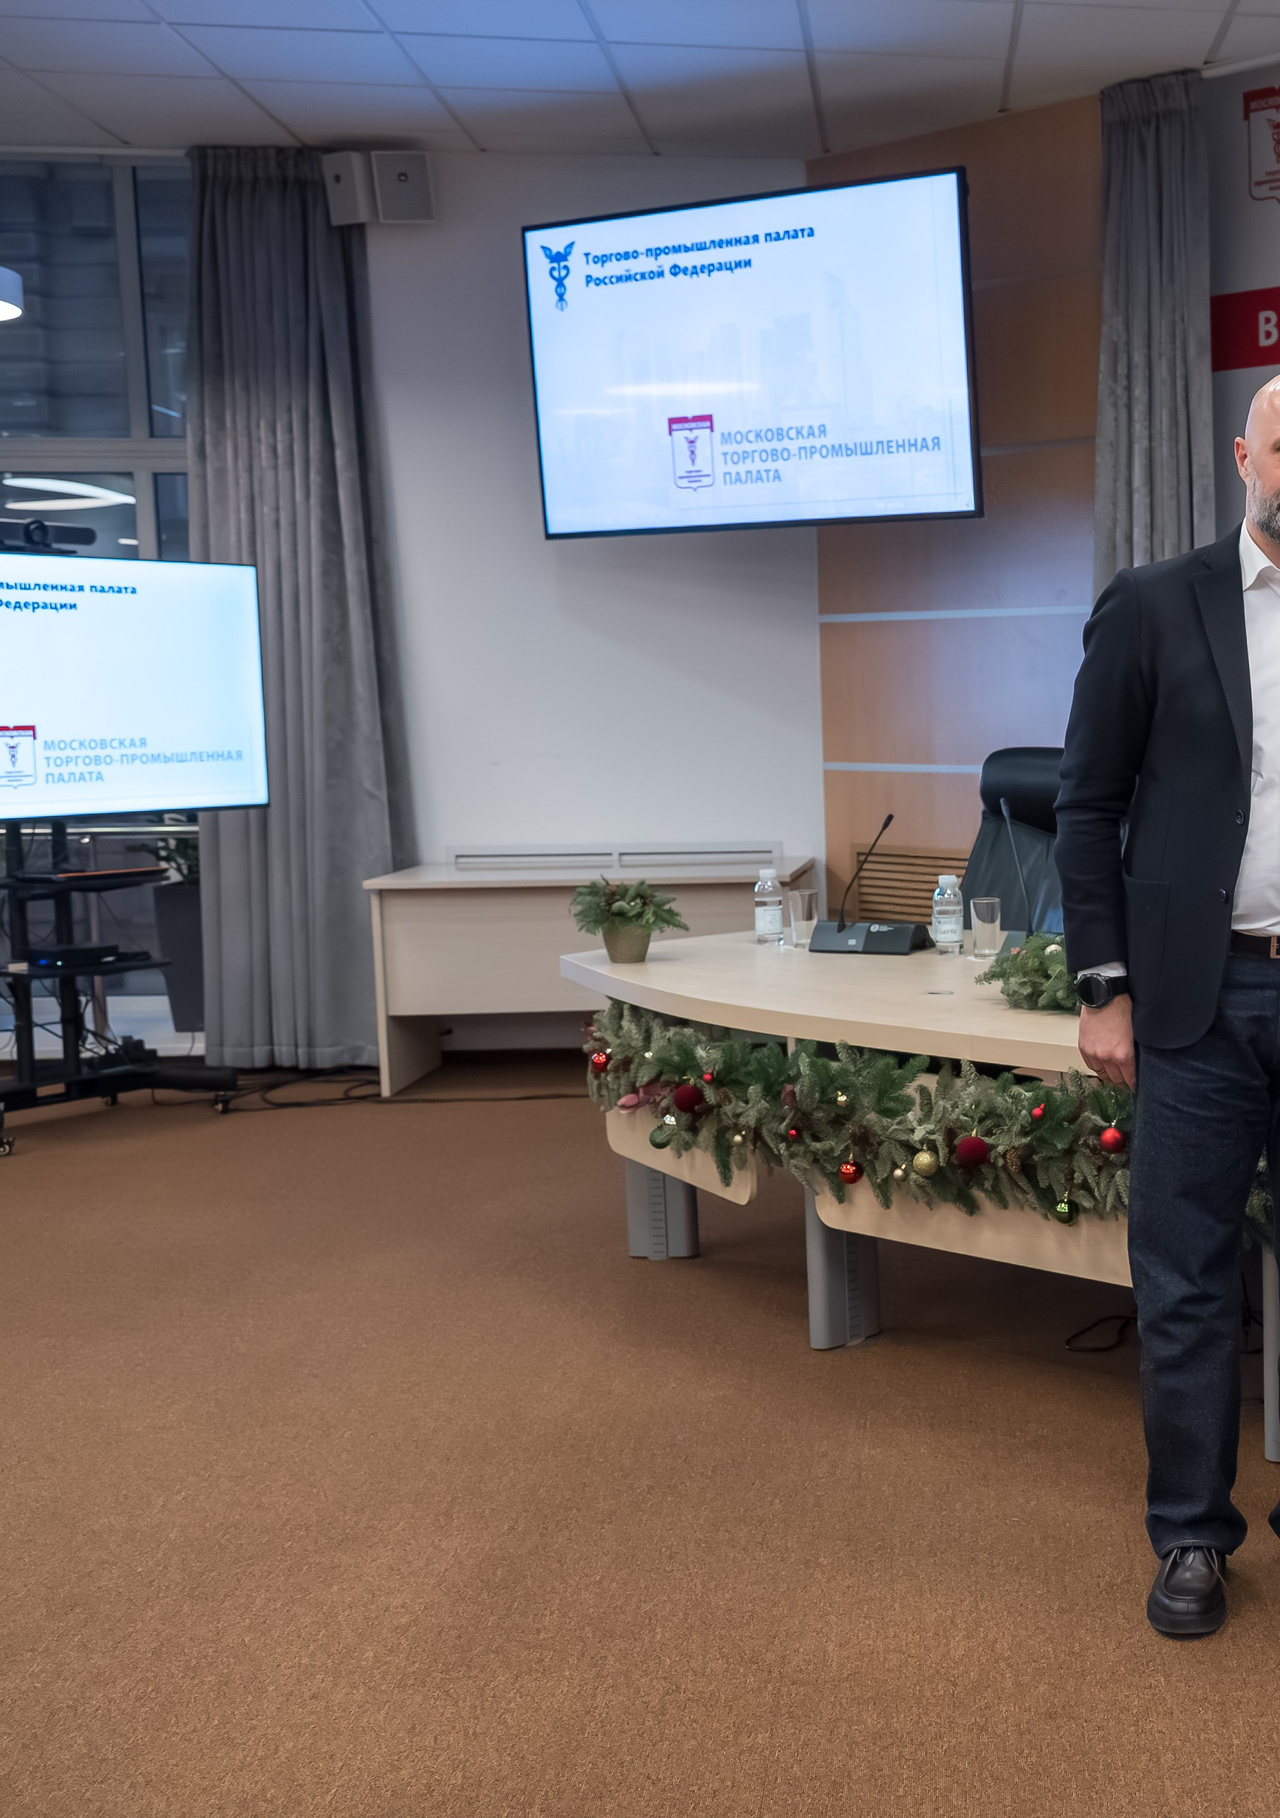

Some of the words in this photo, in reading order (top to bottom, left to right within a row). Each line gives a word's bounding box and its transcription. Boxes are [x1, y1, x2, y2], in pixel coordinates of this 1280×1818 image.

[583, 234, 760, 268] Торгово-промышленная
[765, 227, 814, 243] палата
[585, 265, 665, 287] Российской
[669, 258, 752, 278] Федерации
[1258, 311, 1278, 347] В
[720, 424, 827, 446] МОСКОВСКАЯ
[721, 437, 941, 466] ТОРГОВО-ПРОМЫШЛЕННАЯ
[723, 469, 782, 486] ПАЛАТА
[90, 585, 137, 595] палата
[0, 599, 77, 613] едерации
[43, 737, 147, 752] МОСКОВСКАЯ
[44, 750, 243, 768] ТОРГОВО-ПРОМЫШЛЕННАЯ
[45, 771, 104, 785] ПАЛАТА
